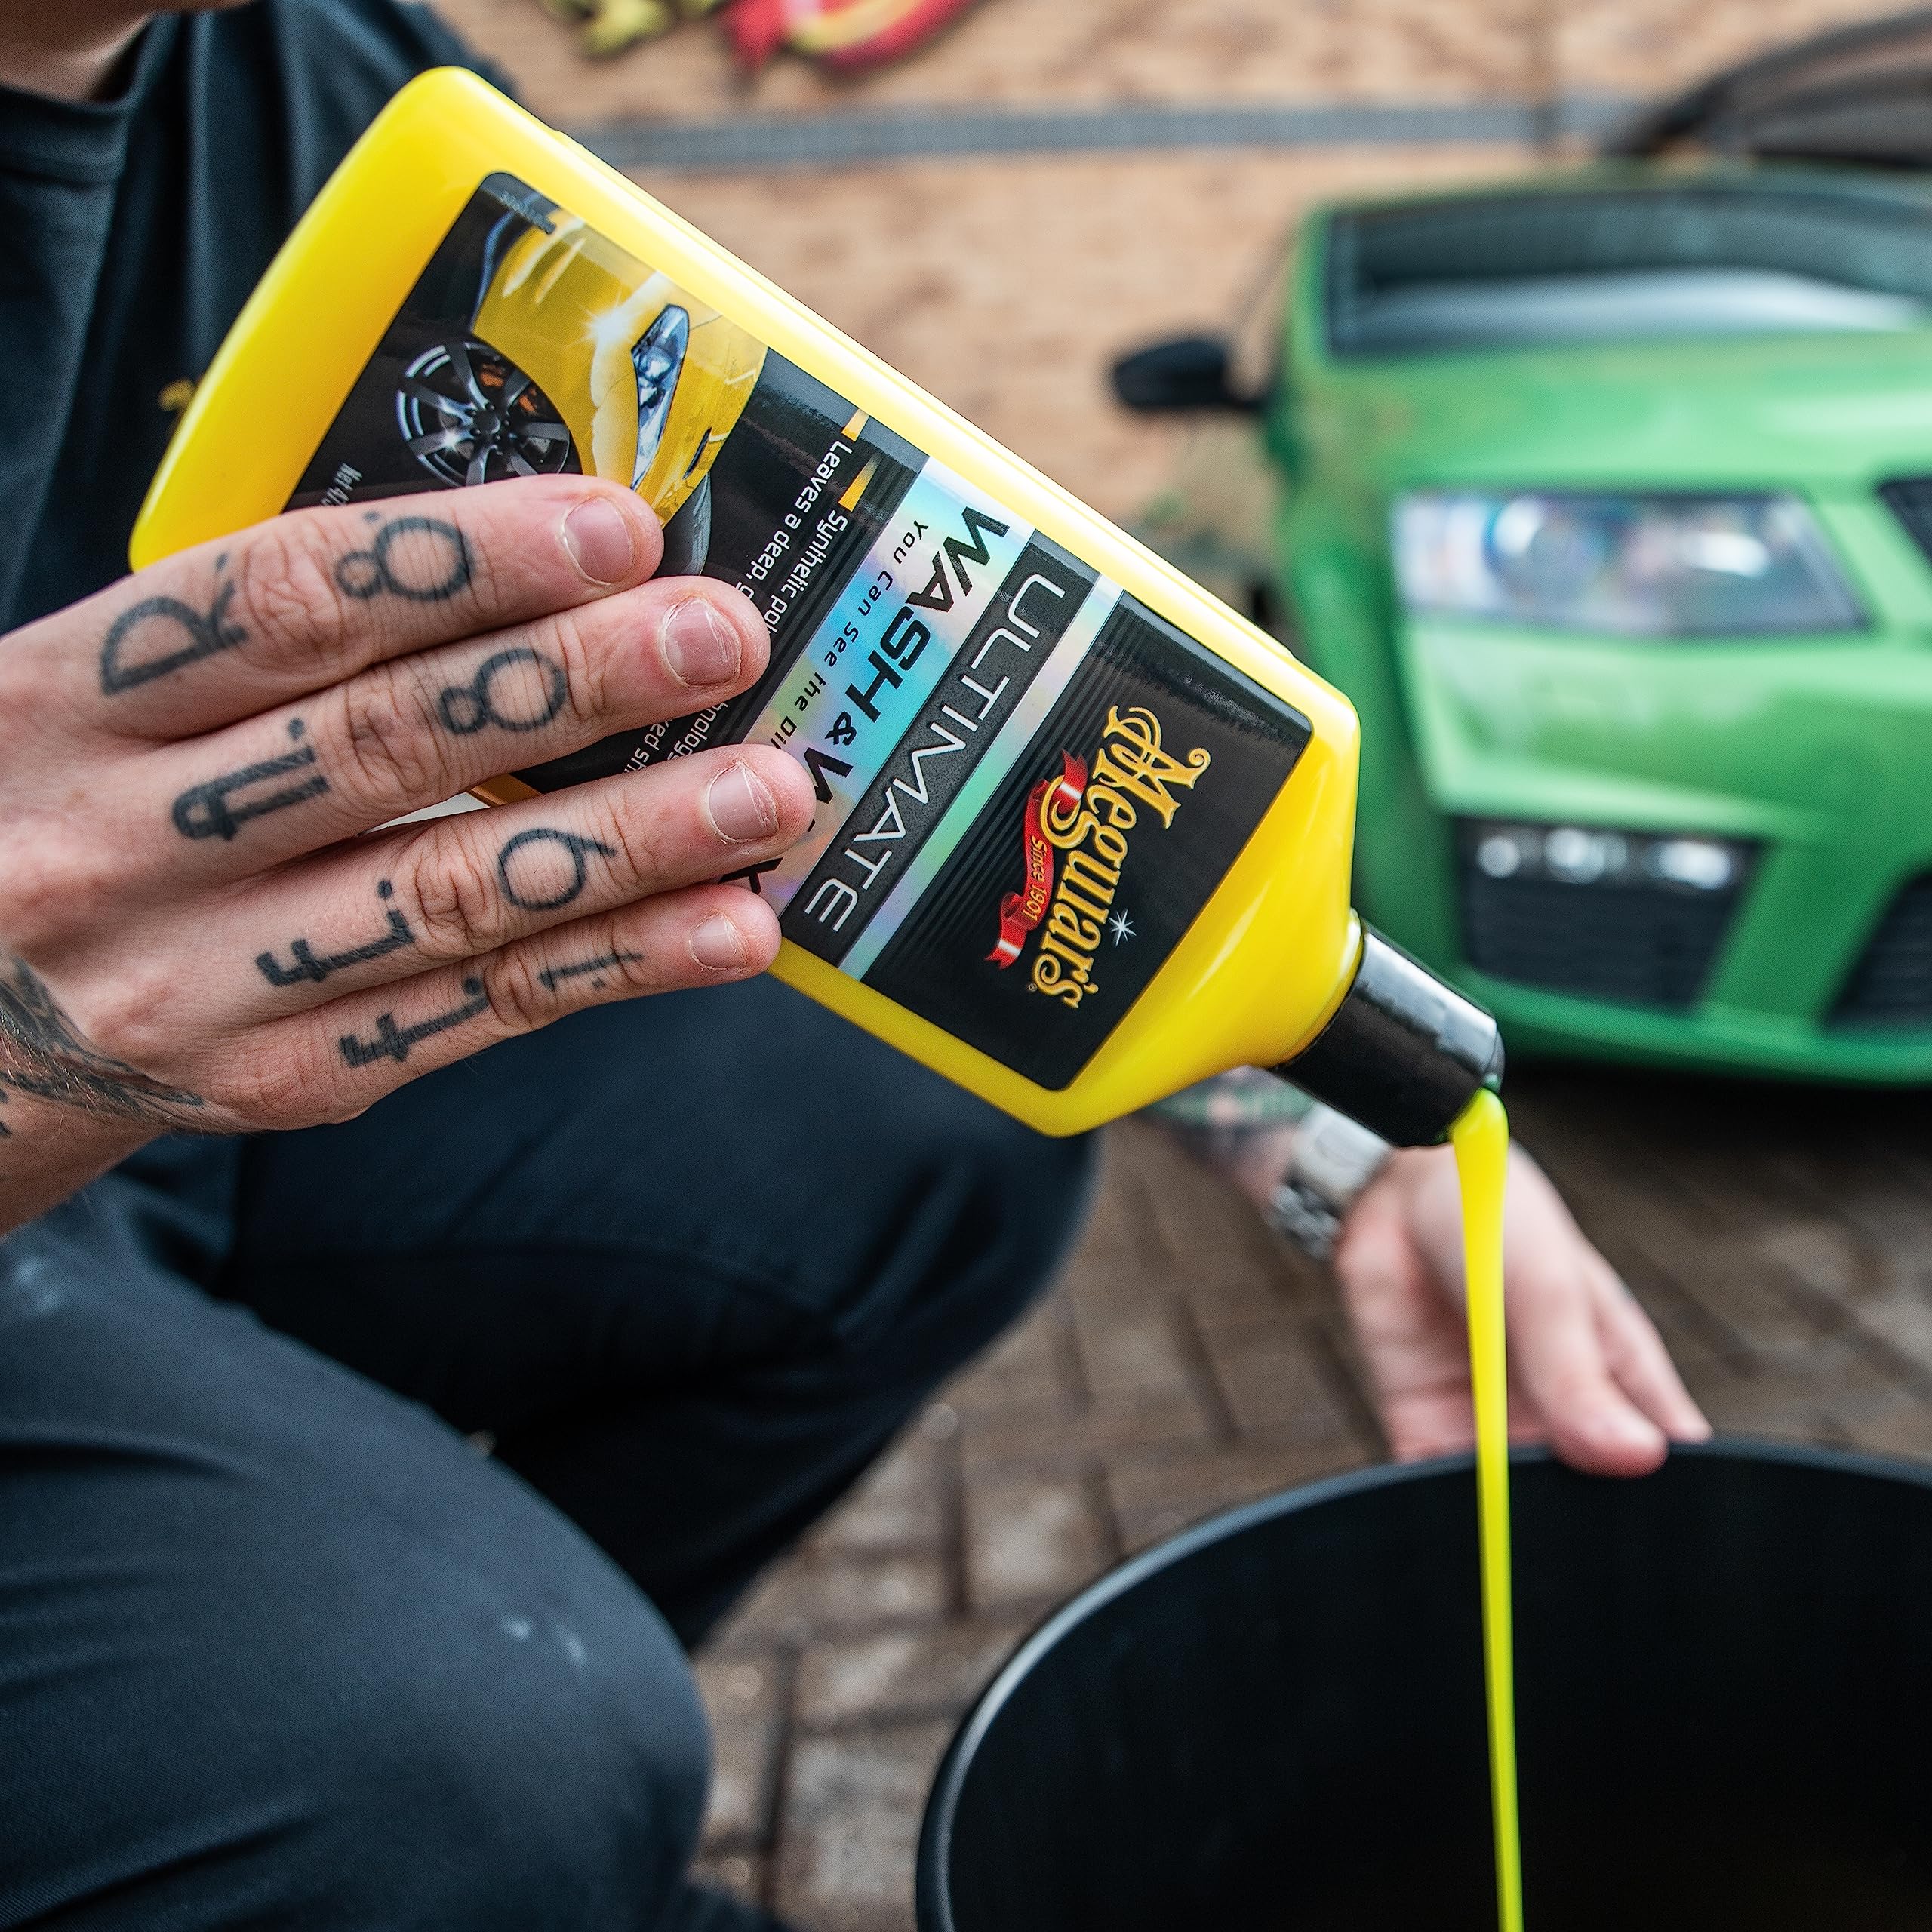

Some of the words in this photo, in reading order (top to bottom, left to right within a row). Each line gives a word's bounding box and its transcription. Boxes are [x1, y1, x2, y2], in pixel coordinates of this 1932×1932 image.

[795, 441, 853, 513] Leaves
[784, 513, 802, 529] a
[893, 520, 929, 564] You
[746, 530, 790, 580] deep,
[781, 510, 848, 598] Synthetic
[844, 506, 1010, 723] WASH
[857, 570, 894, 617] Can
[824, 621, 860, 667] See
[795, 672, 826, 712] the
[825, 711, 857, 746] &
[804, 574, 1066, 932] ULTIMATE
[1031, 835, 1048, 883] Since
[1032, 705, 1211, 1009] Meguiar's
[1023, 884, 1048, 921] 1901
